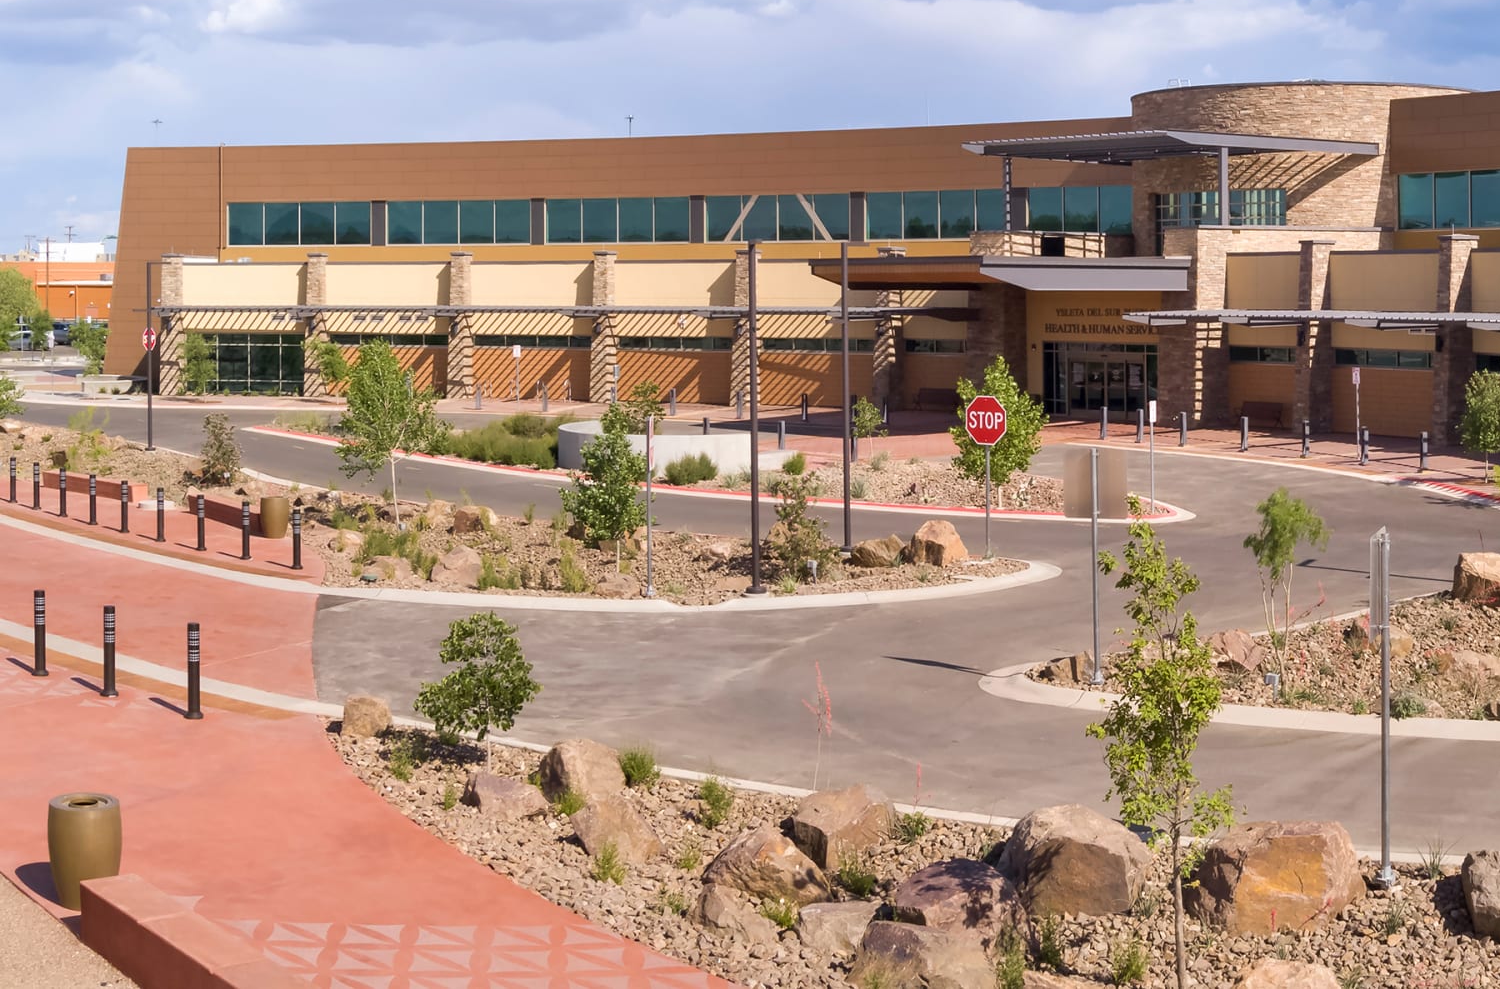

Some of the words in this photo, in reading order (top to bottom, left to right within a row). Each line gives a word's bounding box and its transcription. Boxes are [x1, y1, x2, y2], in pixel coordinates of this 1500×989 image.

[1087, 308, 1104, 316] DEL
[1105, 308, 1120, 316] SUR
[1045, 323, 1080, 333] HEALTH
[1081, 324, 1088, 334] &
[1088, 323, 1124, 334] HUMAN
[968, 410, 1004, 430] STOP
